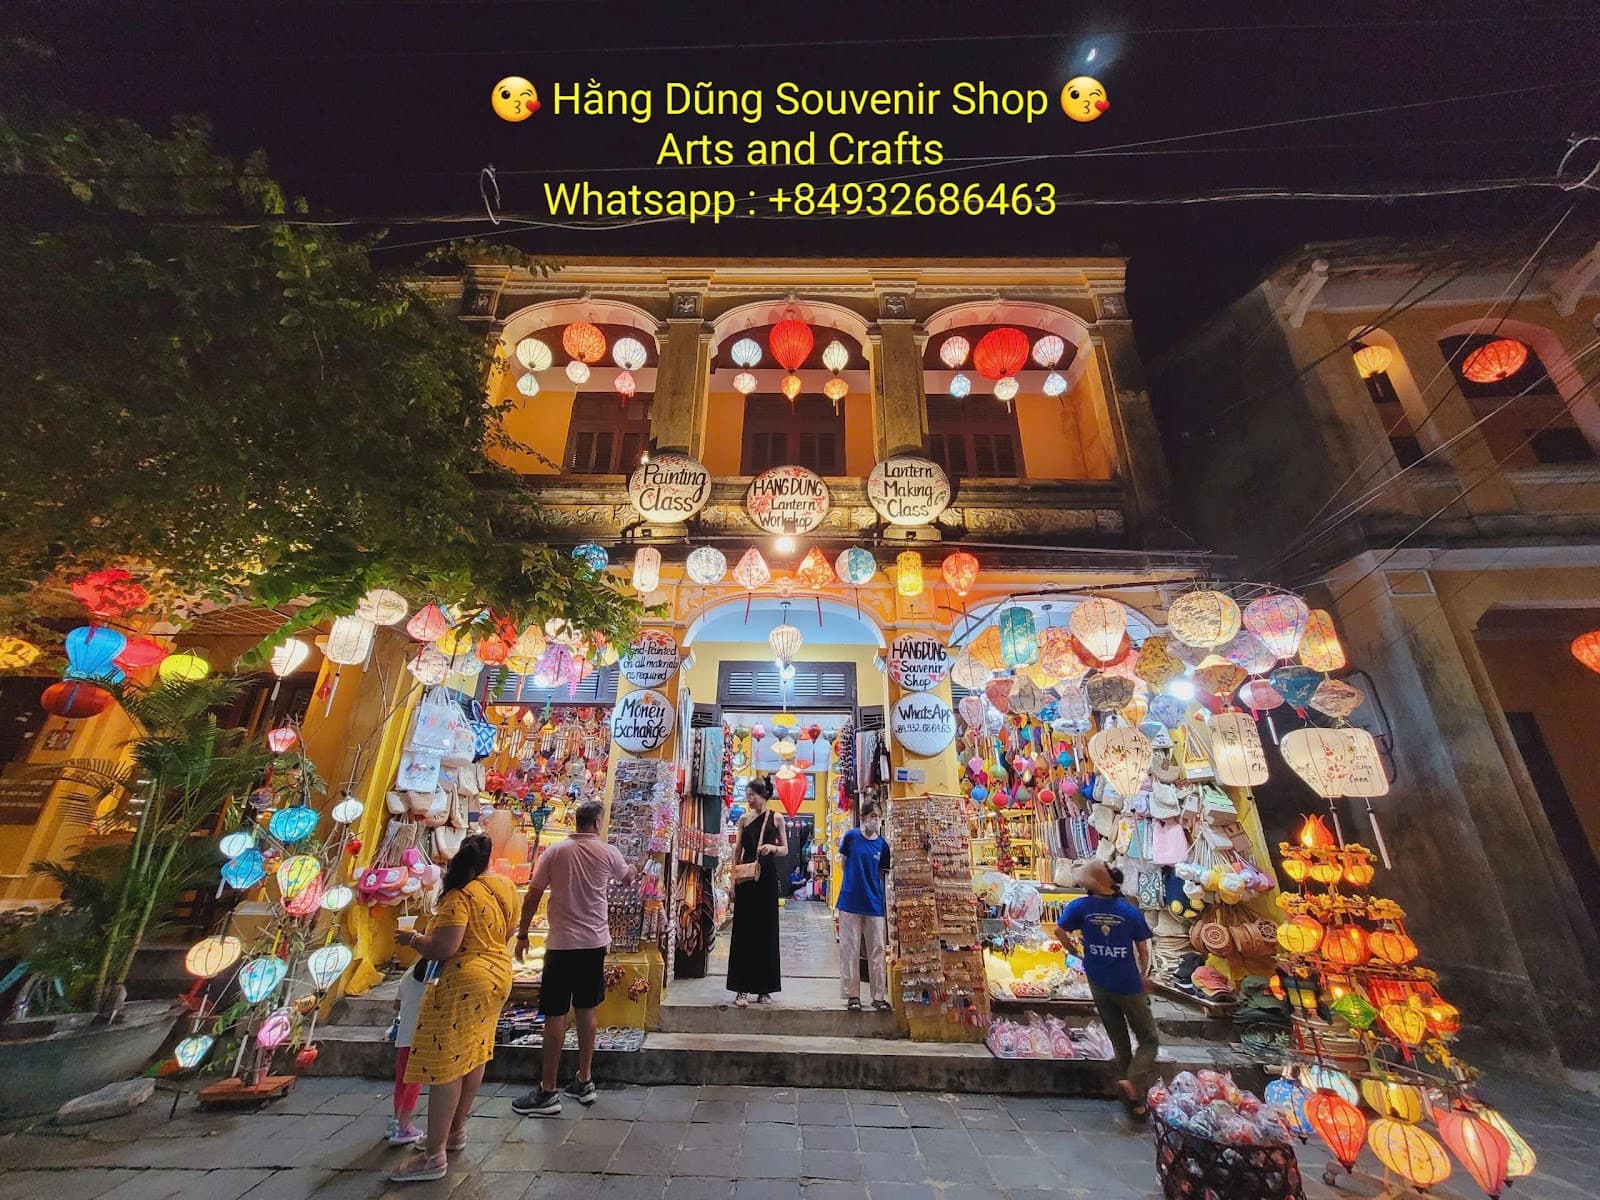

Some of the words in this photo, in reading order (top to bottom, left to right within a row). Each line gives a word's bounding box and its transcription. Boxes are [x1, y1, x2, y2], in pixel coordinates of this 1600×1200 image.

[884, 462, 933, 478] Lantern
[643, 463, 706, 504] Painting
[639, 486, 693, 512] Class
[883, 480, 933, 507] Making
[771, 498, 817, 511] Lantern
[887, 498, 929, 518] Class
[900, 660, 944, 673] Souvenir
[903, 673, 932, 691] Shop
[621, 698, 666, 727] Money
[898, 704, 951, 723] WhatsApp
[613, 717, 669, 749] Exchange
[1089, 944, 1128, 959] STAFF
